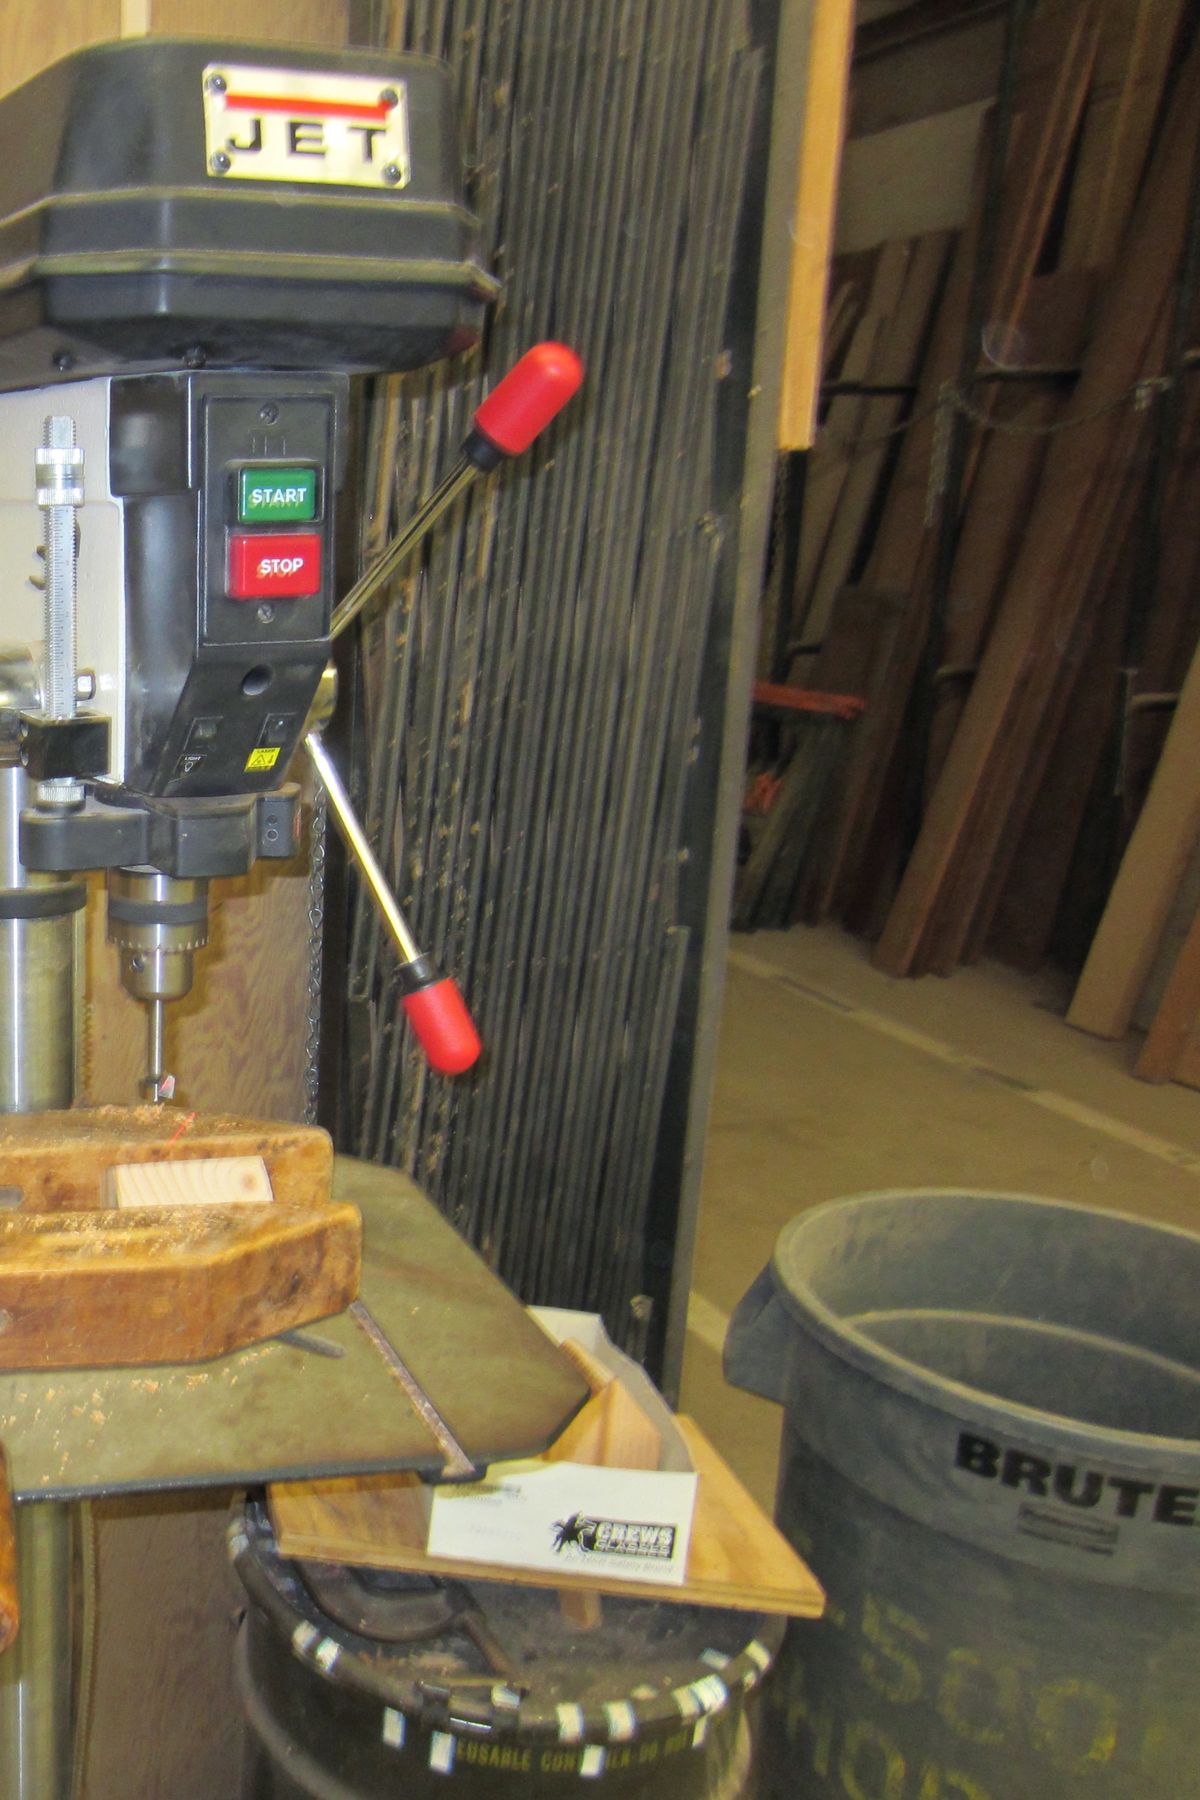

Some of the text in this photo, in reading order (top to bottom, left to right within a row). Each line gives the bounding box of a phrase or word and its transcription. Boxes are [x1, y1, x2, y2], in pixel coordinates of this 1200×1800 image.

[226, 118, 387, 163] JET
[251, 487, 307, 504] START
[260, 557, 304, 574] STOP
[953, 1431, 1200, 1527] BRUTE
[596, 1520, 674, 1545] CREWS
